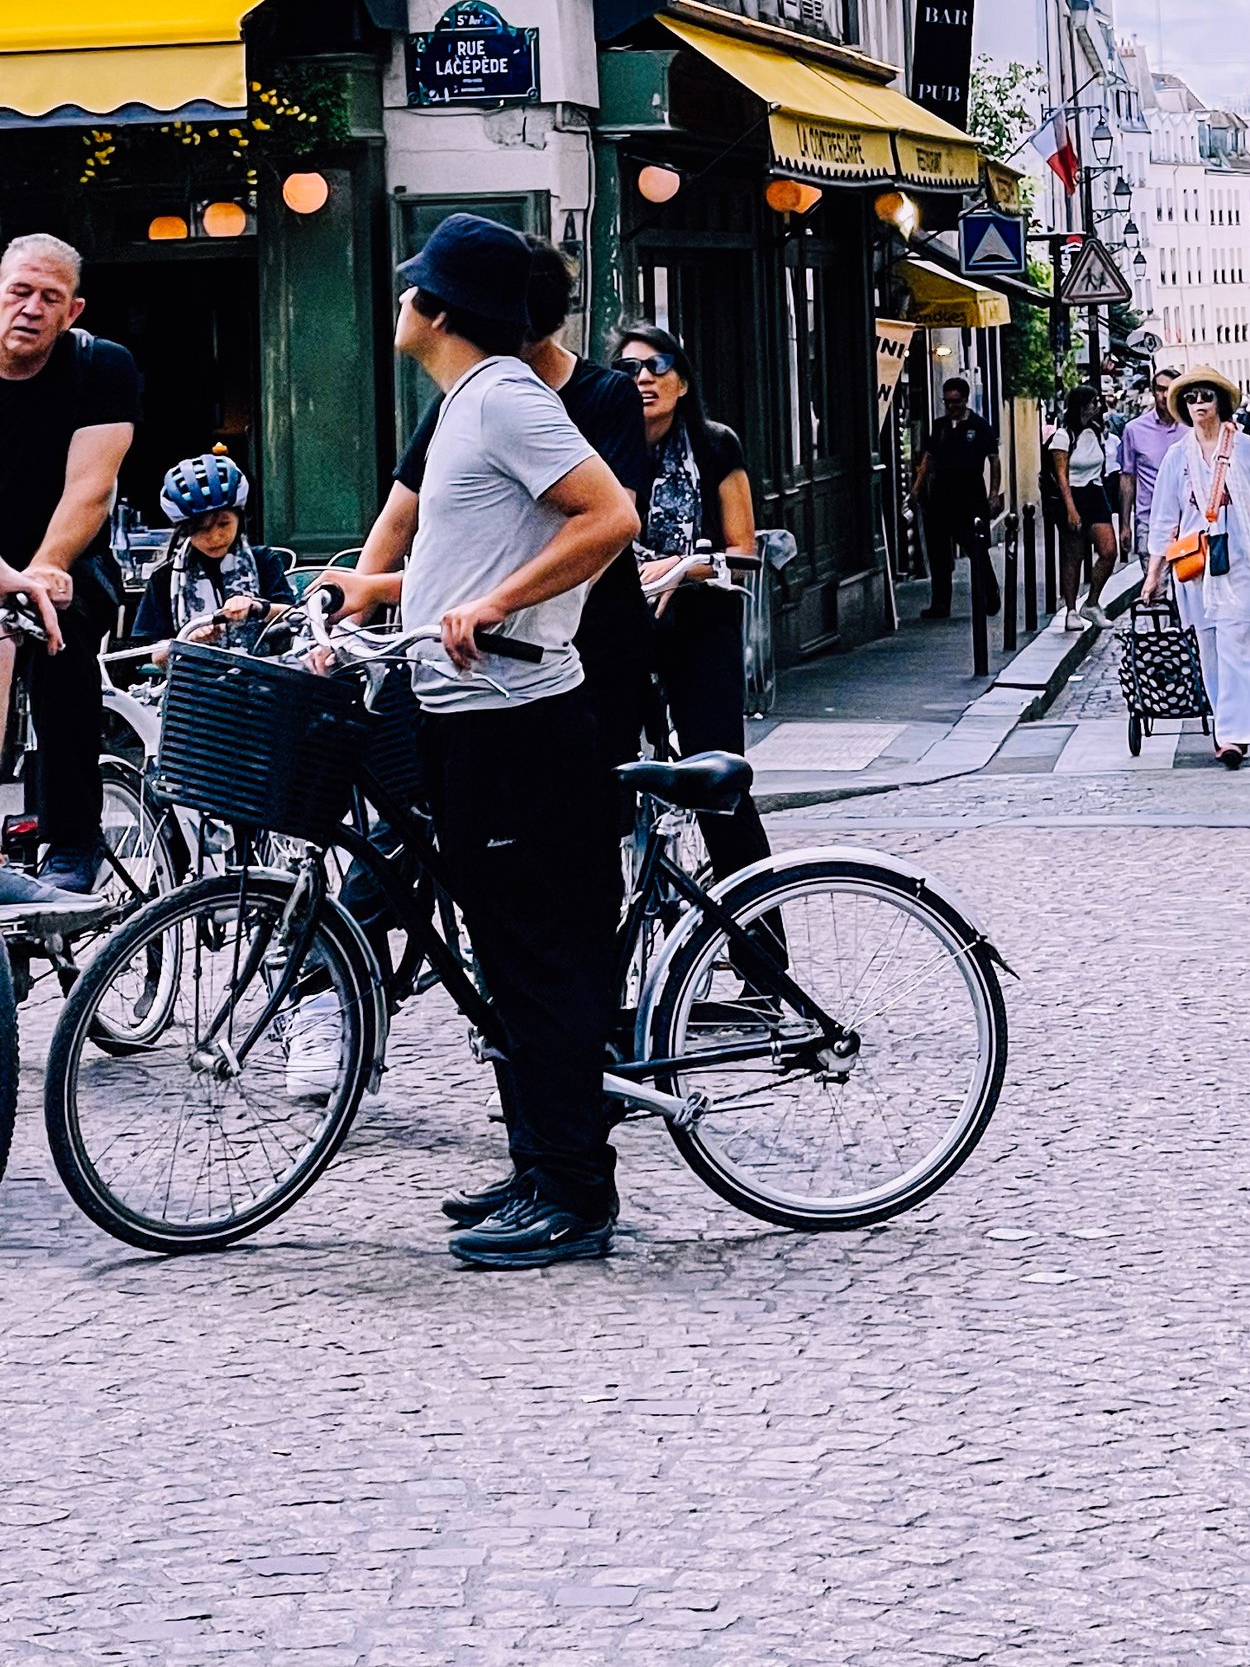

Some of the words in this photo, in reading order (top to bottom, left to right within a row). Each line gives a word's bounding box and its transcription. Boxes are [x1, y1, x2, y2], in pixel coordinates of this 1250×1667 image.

[925, 6, 968, 26] BAR
[457, 40, 485, 56] RUE
[435, 56, 508, 75] LACÉPÈDE
[918, 84, 961, 102] PUB
